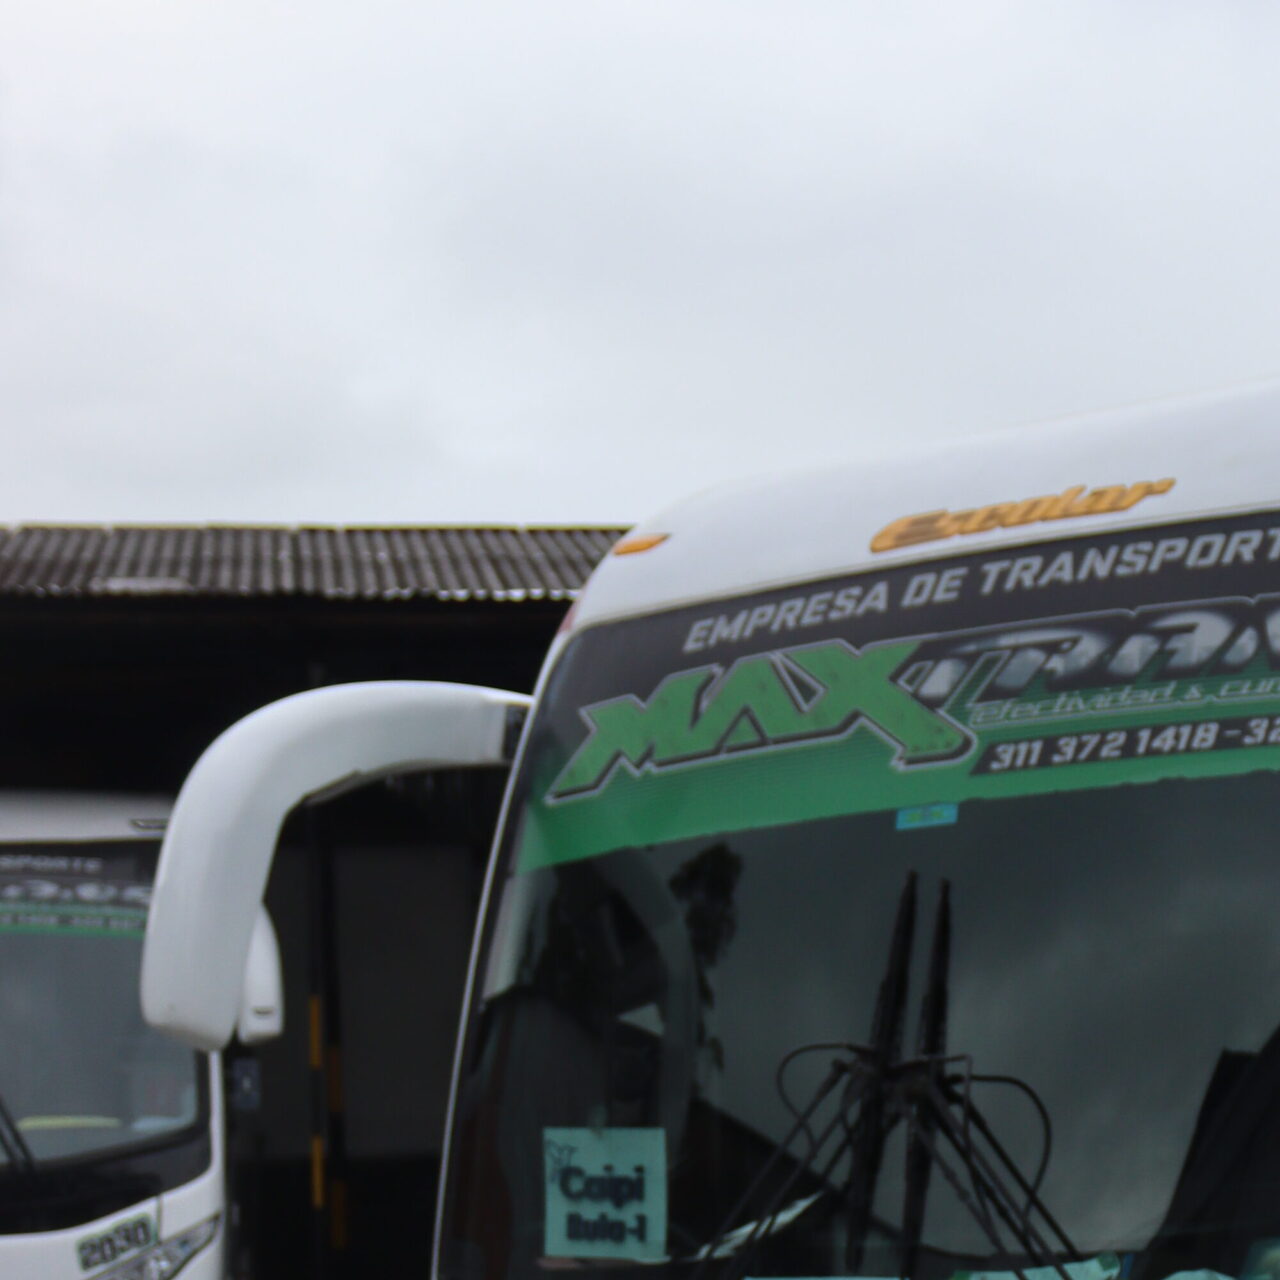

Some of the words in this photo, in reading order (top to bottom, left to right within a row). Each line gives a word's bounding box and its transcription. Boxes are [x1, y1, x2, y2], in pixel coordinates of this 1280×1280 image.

[870, 478, 1176, 553] Escolar
[683, 583, 888, 653] EMPRESA
[900, 566, 968, 608] DE
[544, 638, 978, 805] MAX
[990, 739, 1045, 772] 311
[1052, 730, 1128, 764] 372
